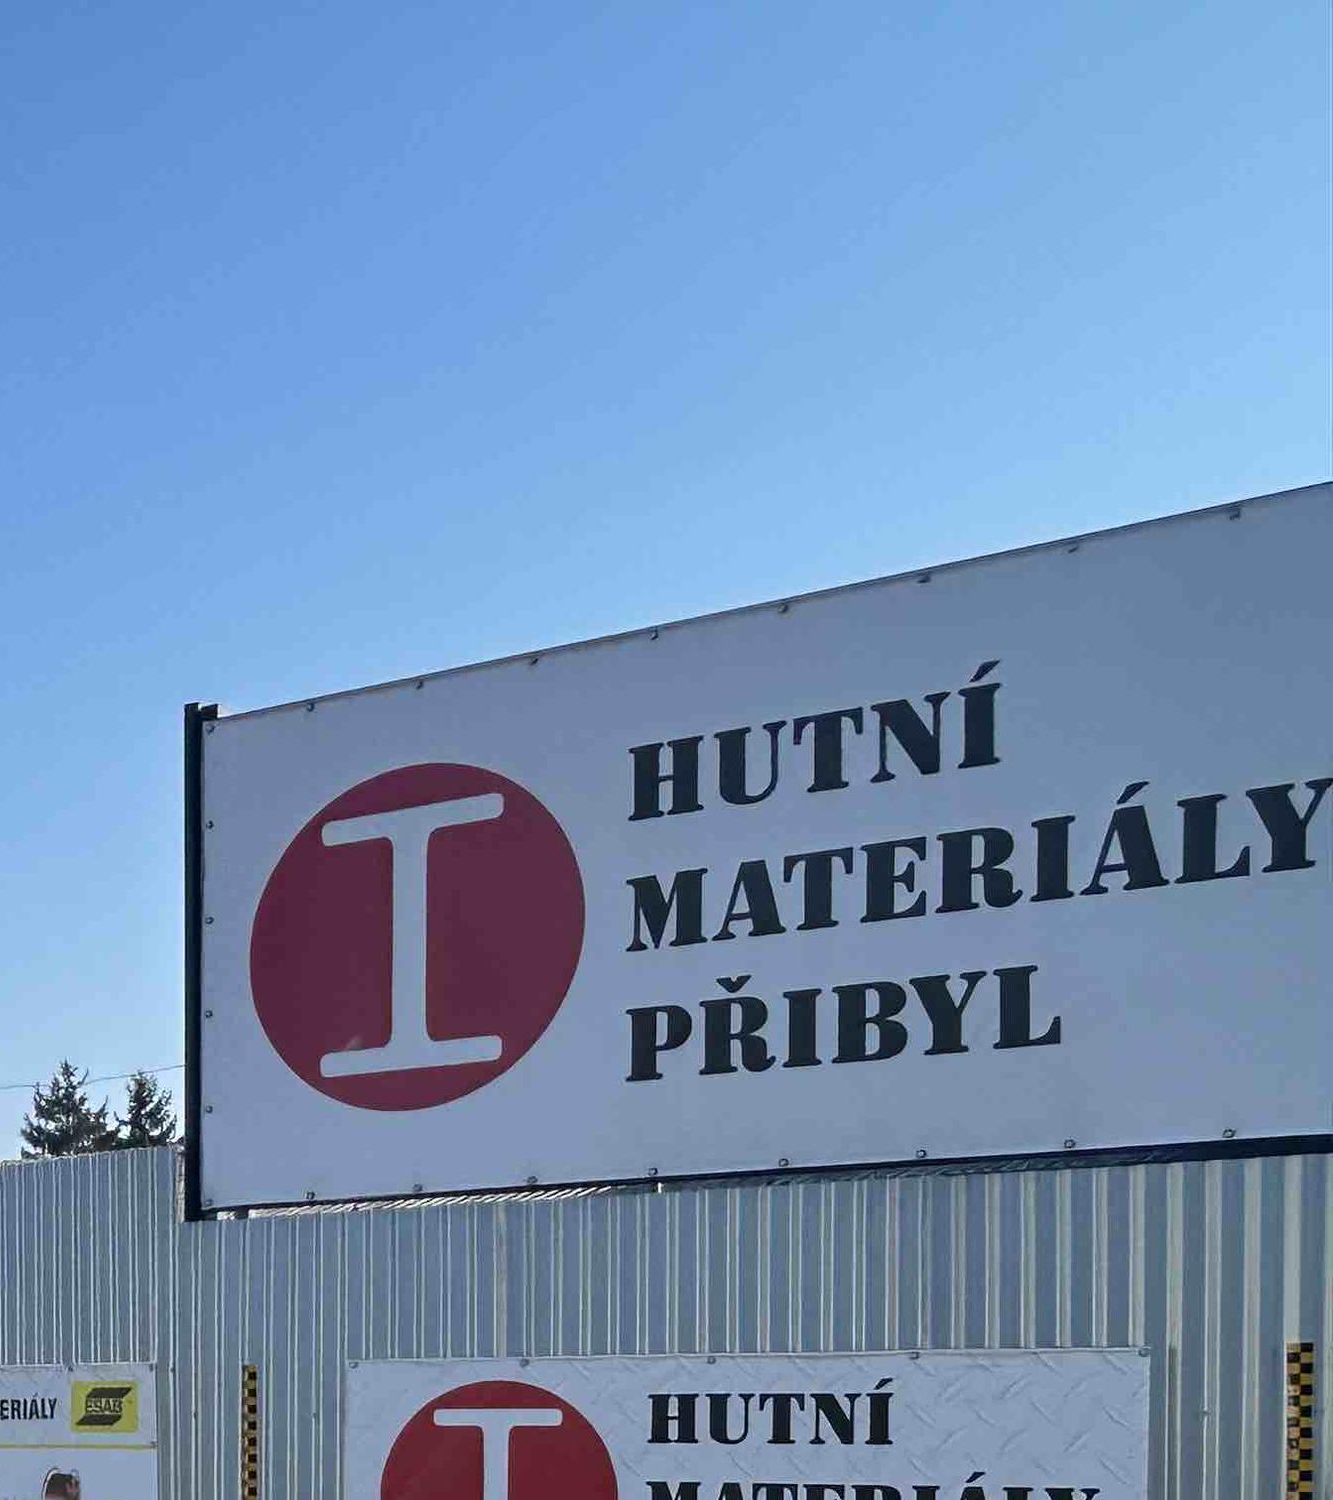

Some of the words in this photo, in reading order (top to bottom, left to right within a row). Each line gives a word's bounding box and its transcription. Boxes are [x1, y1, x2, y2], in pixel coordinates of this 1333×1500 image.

[628, 660, 1001, 821] HUTNÍ
[626, 777, 1333, 952] MATERIÁLY
[625, 964, 1062, 1082] PŘIBYL
[647, 1378, 894, 1446] HUTNÍ
